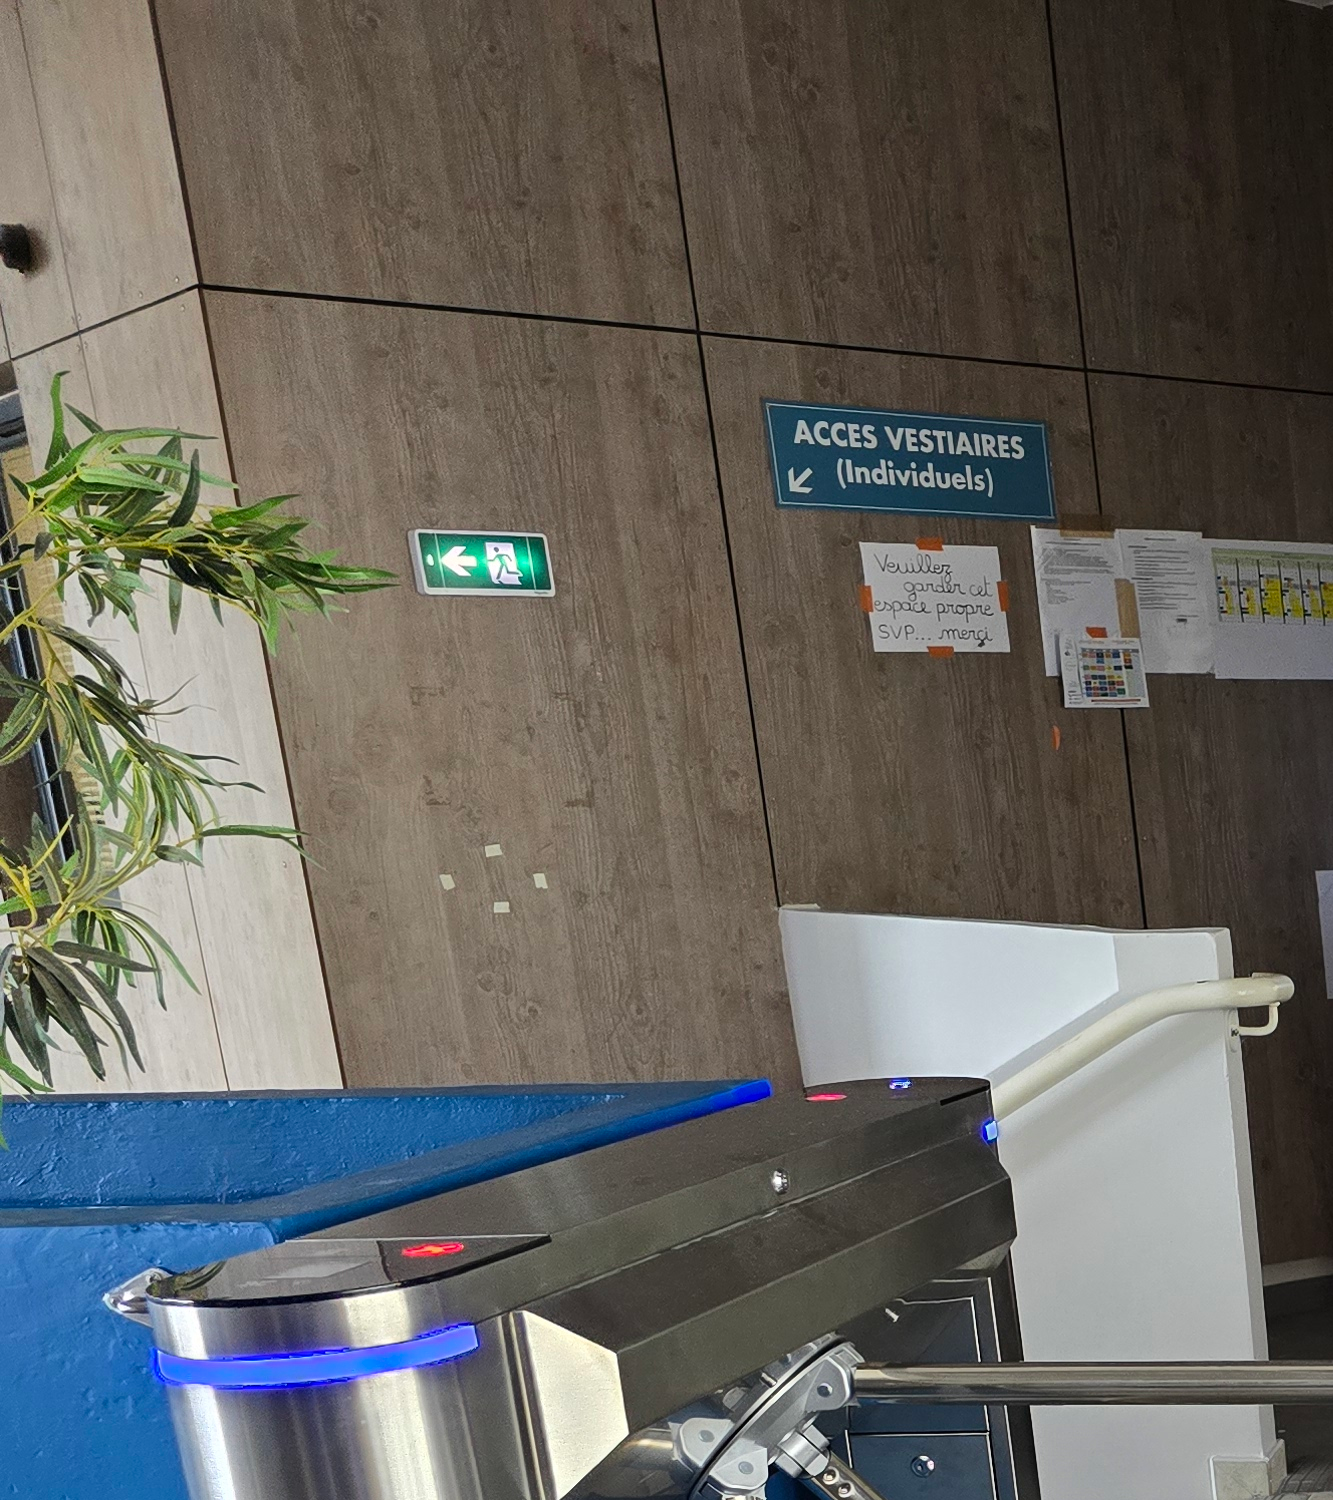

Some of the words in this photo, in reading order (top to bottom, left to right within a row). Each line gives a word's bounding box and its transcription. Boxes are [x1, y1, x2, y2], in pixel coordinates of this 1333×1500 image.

[794, 419, 878, 449] ACCES
[884, 426, 1025, 459] VESTIAIRES
[837, 457, 994, 498] (Individuels)
[873, 553, 953, 583] Veuillez
[903, 575, 966, 601] garder
[969, 575, 993, 597] cet
[874, 600, 932, 620] espace
[936, 602, 994, 623] propre
